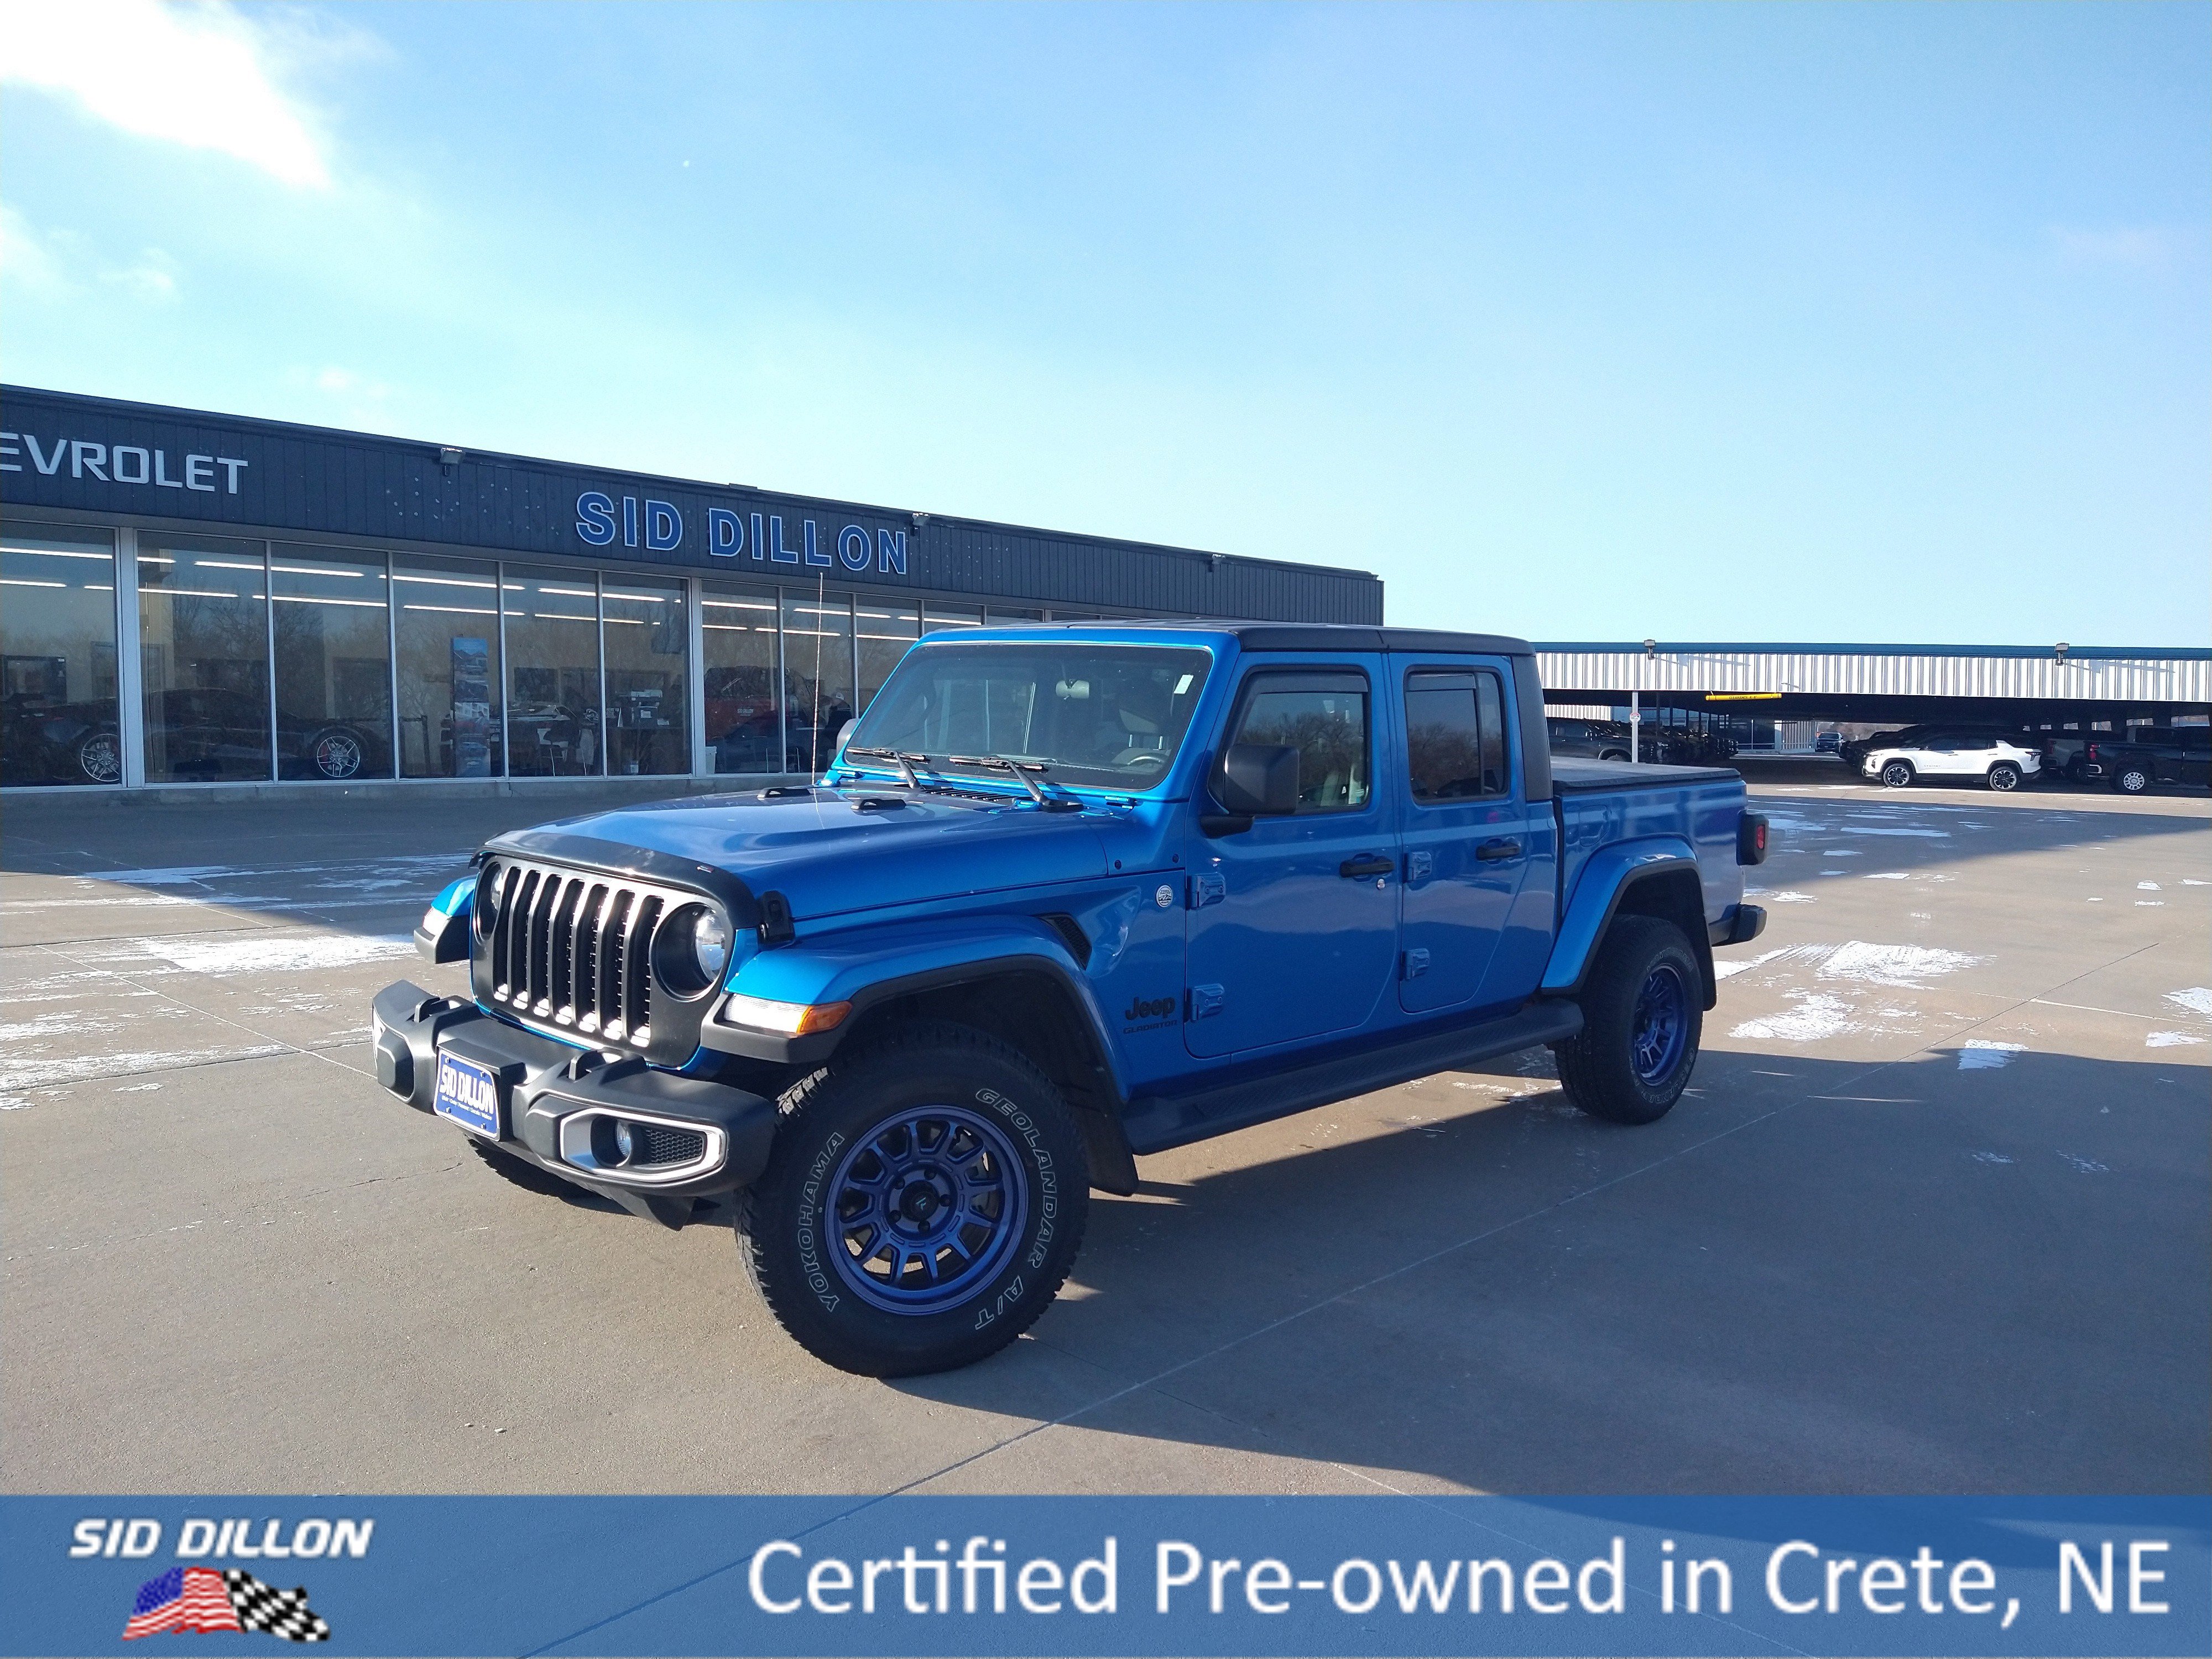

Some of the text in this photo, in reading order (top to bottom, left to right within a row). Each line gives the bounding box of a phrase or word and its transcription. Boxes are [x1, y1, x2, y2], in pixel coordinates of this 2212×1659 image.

[0, 432, 248, 495] EVROLET
[575, 491, 907, 576] SID DILLON
[1123, 1020, 1177, 1034] GLADIATOR
[1125, 997, 1176, 1020] Jeep
[439, 1064, 457, 1098] SID
[457, 1071, 494, 1115] DILLON
[798, 1132, 845, 1312] YOKOHAMA
[975, 1088, 1057, 1330] GEOLANDAR A/T
